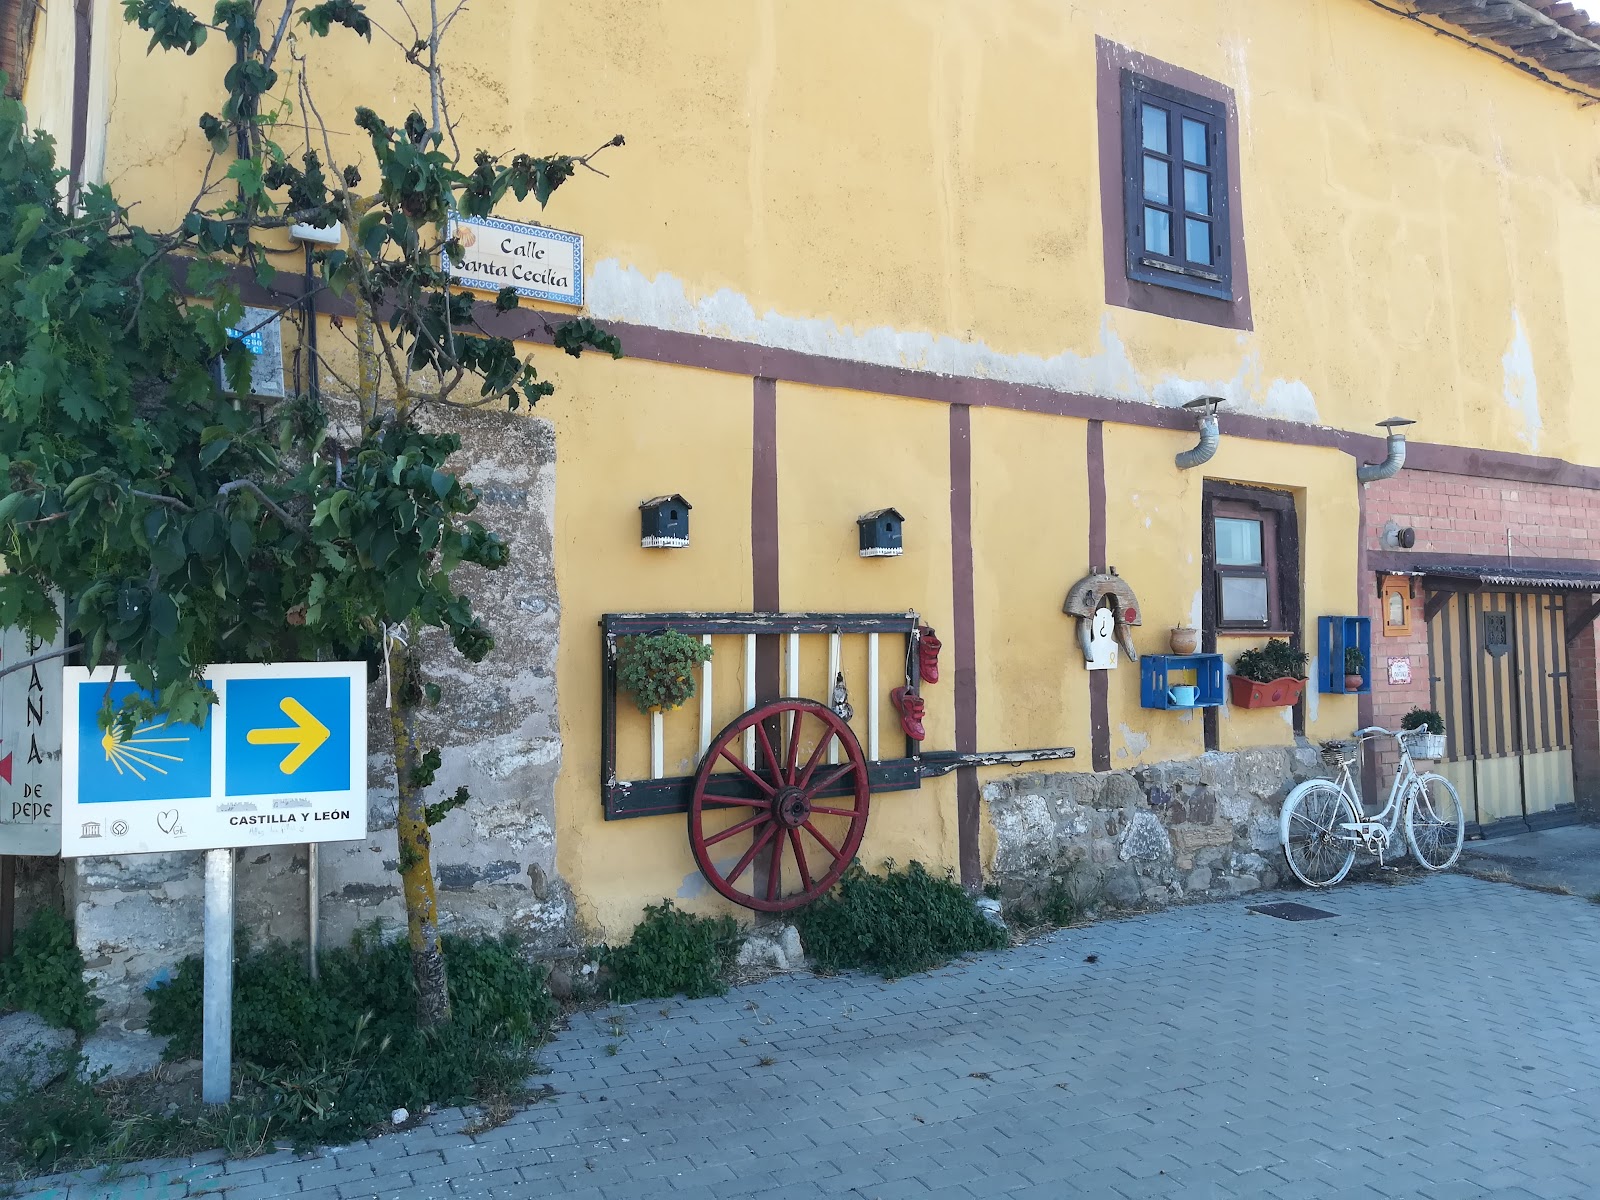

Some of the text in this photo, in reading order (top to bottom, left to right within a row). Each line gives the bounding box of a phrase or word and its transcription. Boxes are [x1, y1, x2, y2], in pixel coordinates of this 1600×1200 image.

[501, 238, 545, 260] Calle
[512, 264, 568, 287] Cecilia
[23, 783, 43, 798] DE
[12, 802, 53, 820] PEPE
[229, 809, 350, 826] CASTILLA Y LEÓN
